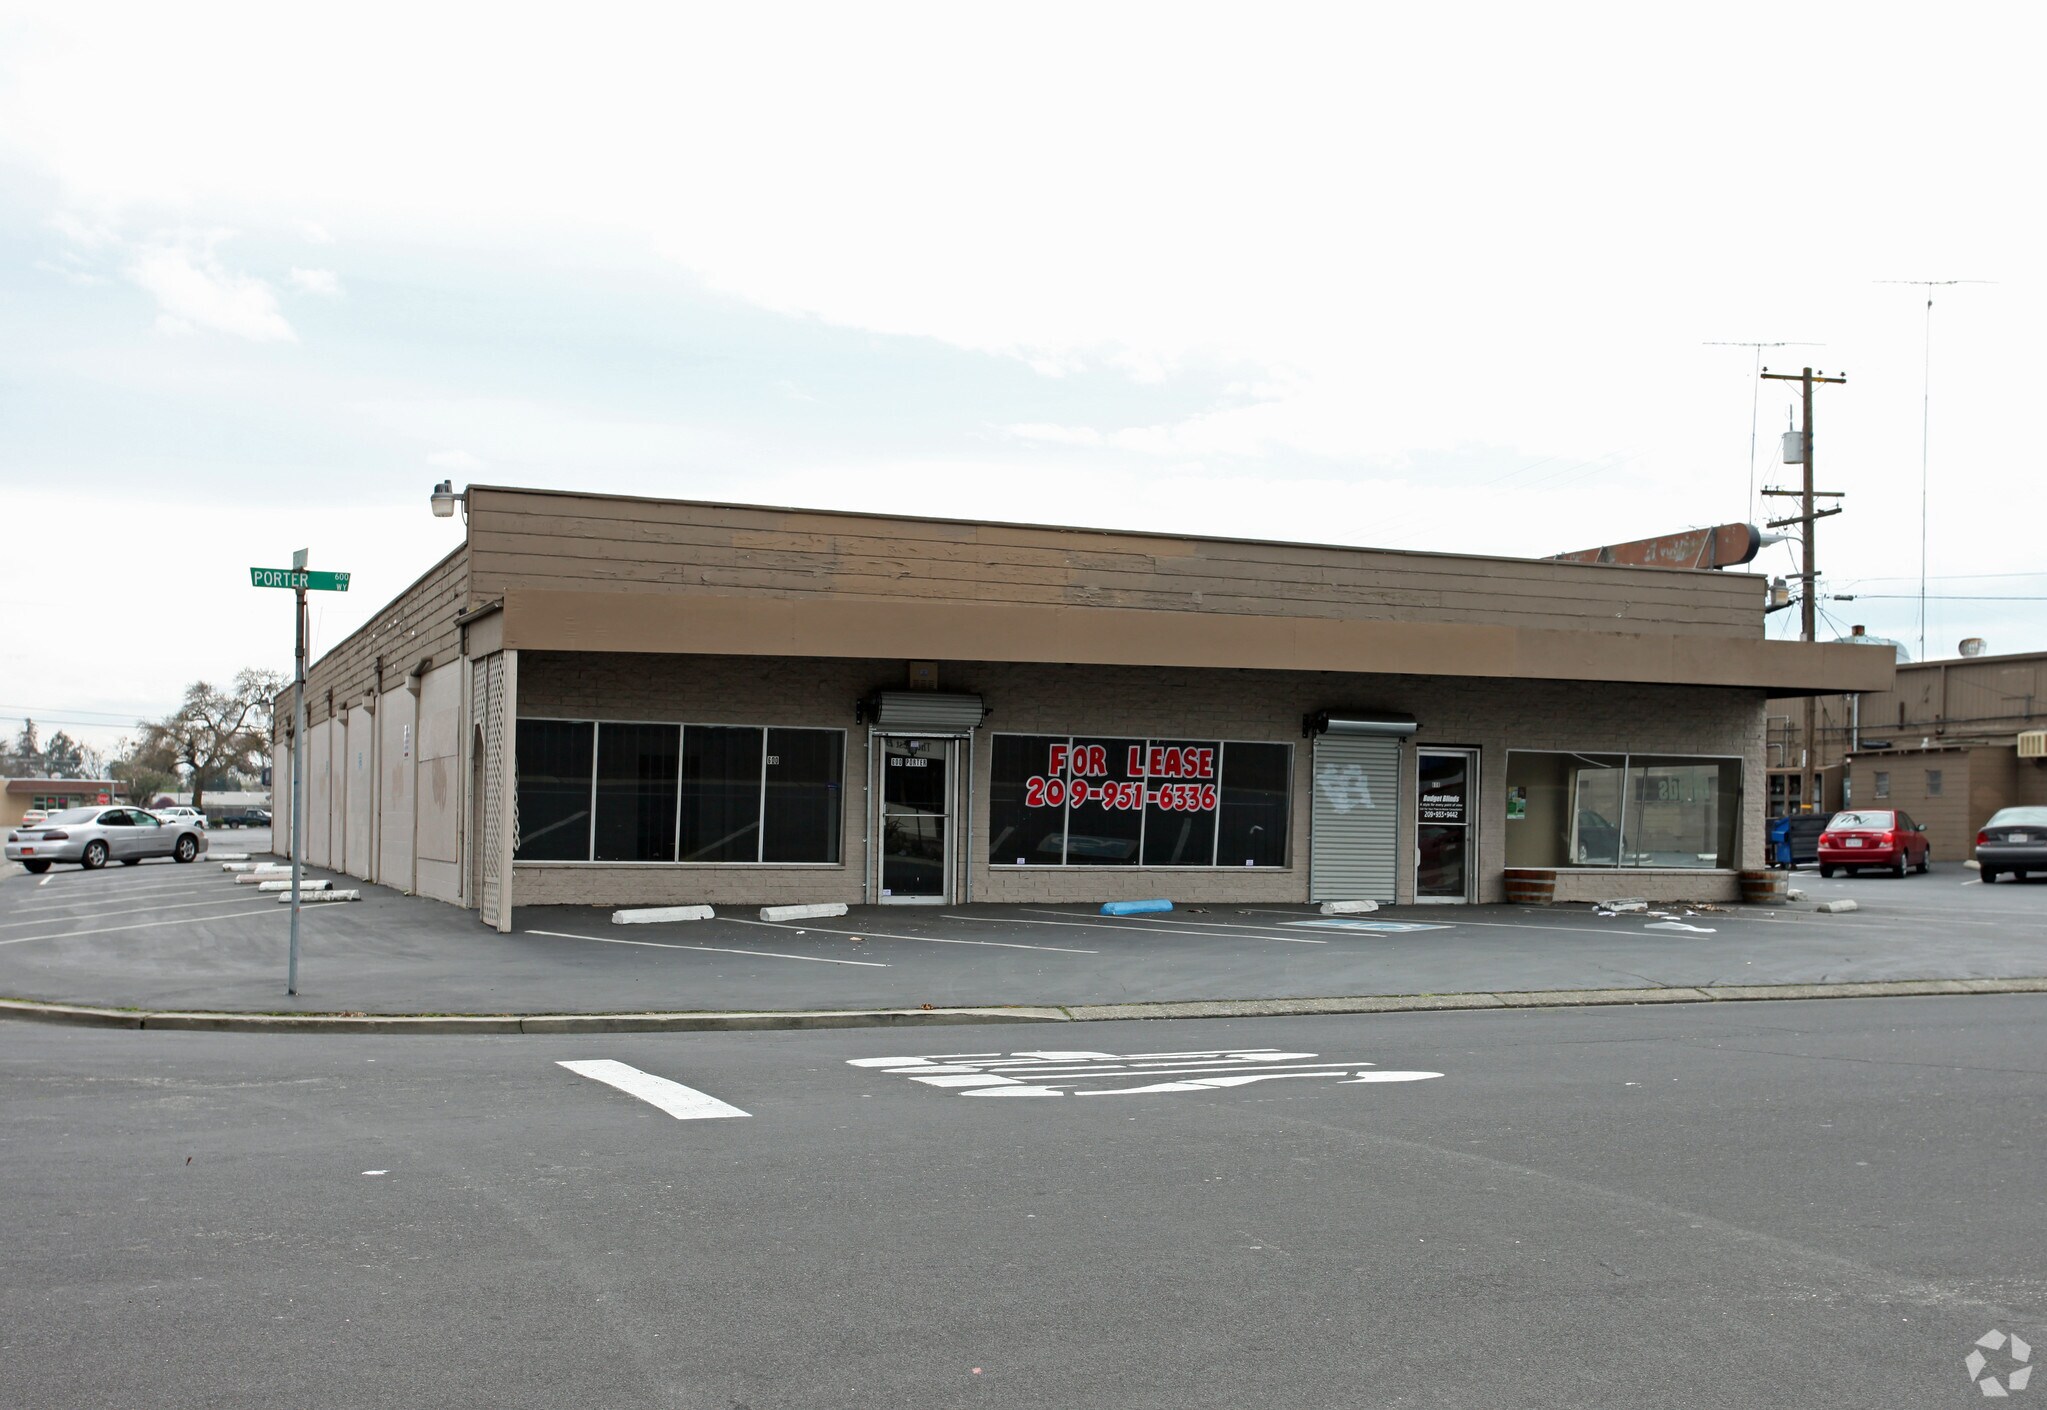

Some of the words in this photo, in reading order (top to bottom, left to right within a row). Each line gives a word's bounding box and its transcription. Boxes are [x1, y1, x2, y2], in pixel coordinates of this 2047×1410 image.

[254, 571, 308, 587] PORTER
[334, 573, 349, 581] 600
[336, 583, 347, 591] WY
[1048, 743, 1108, 777] FOR
[1127, 745, 1214, 779] LEASE
[1025, 776, 1216, 812] 209-951-6336
